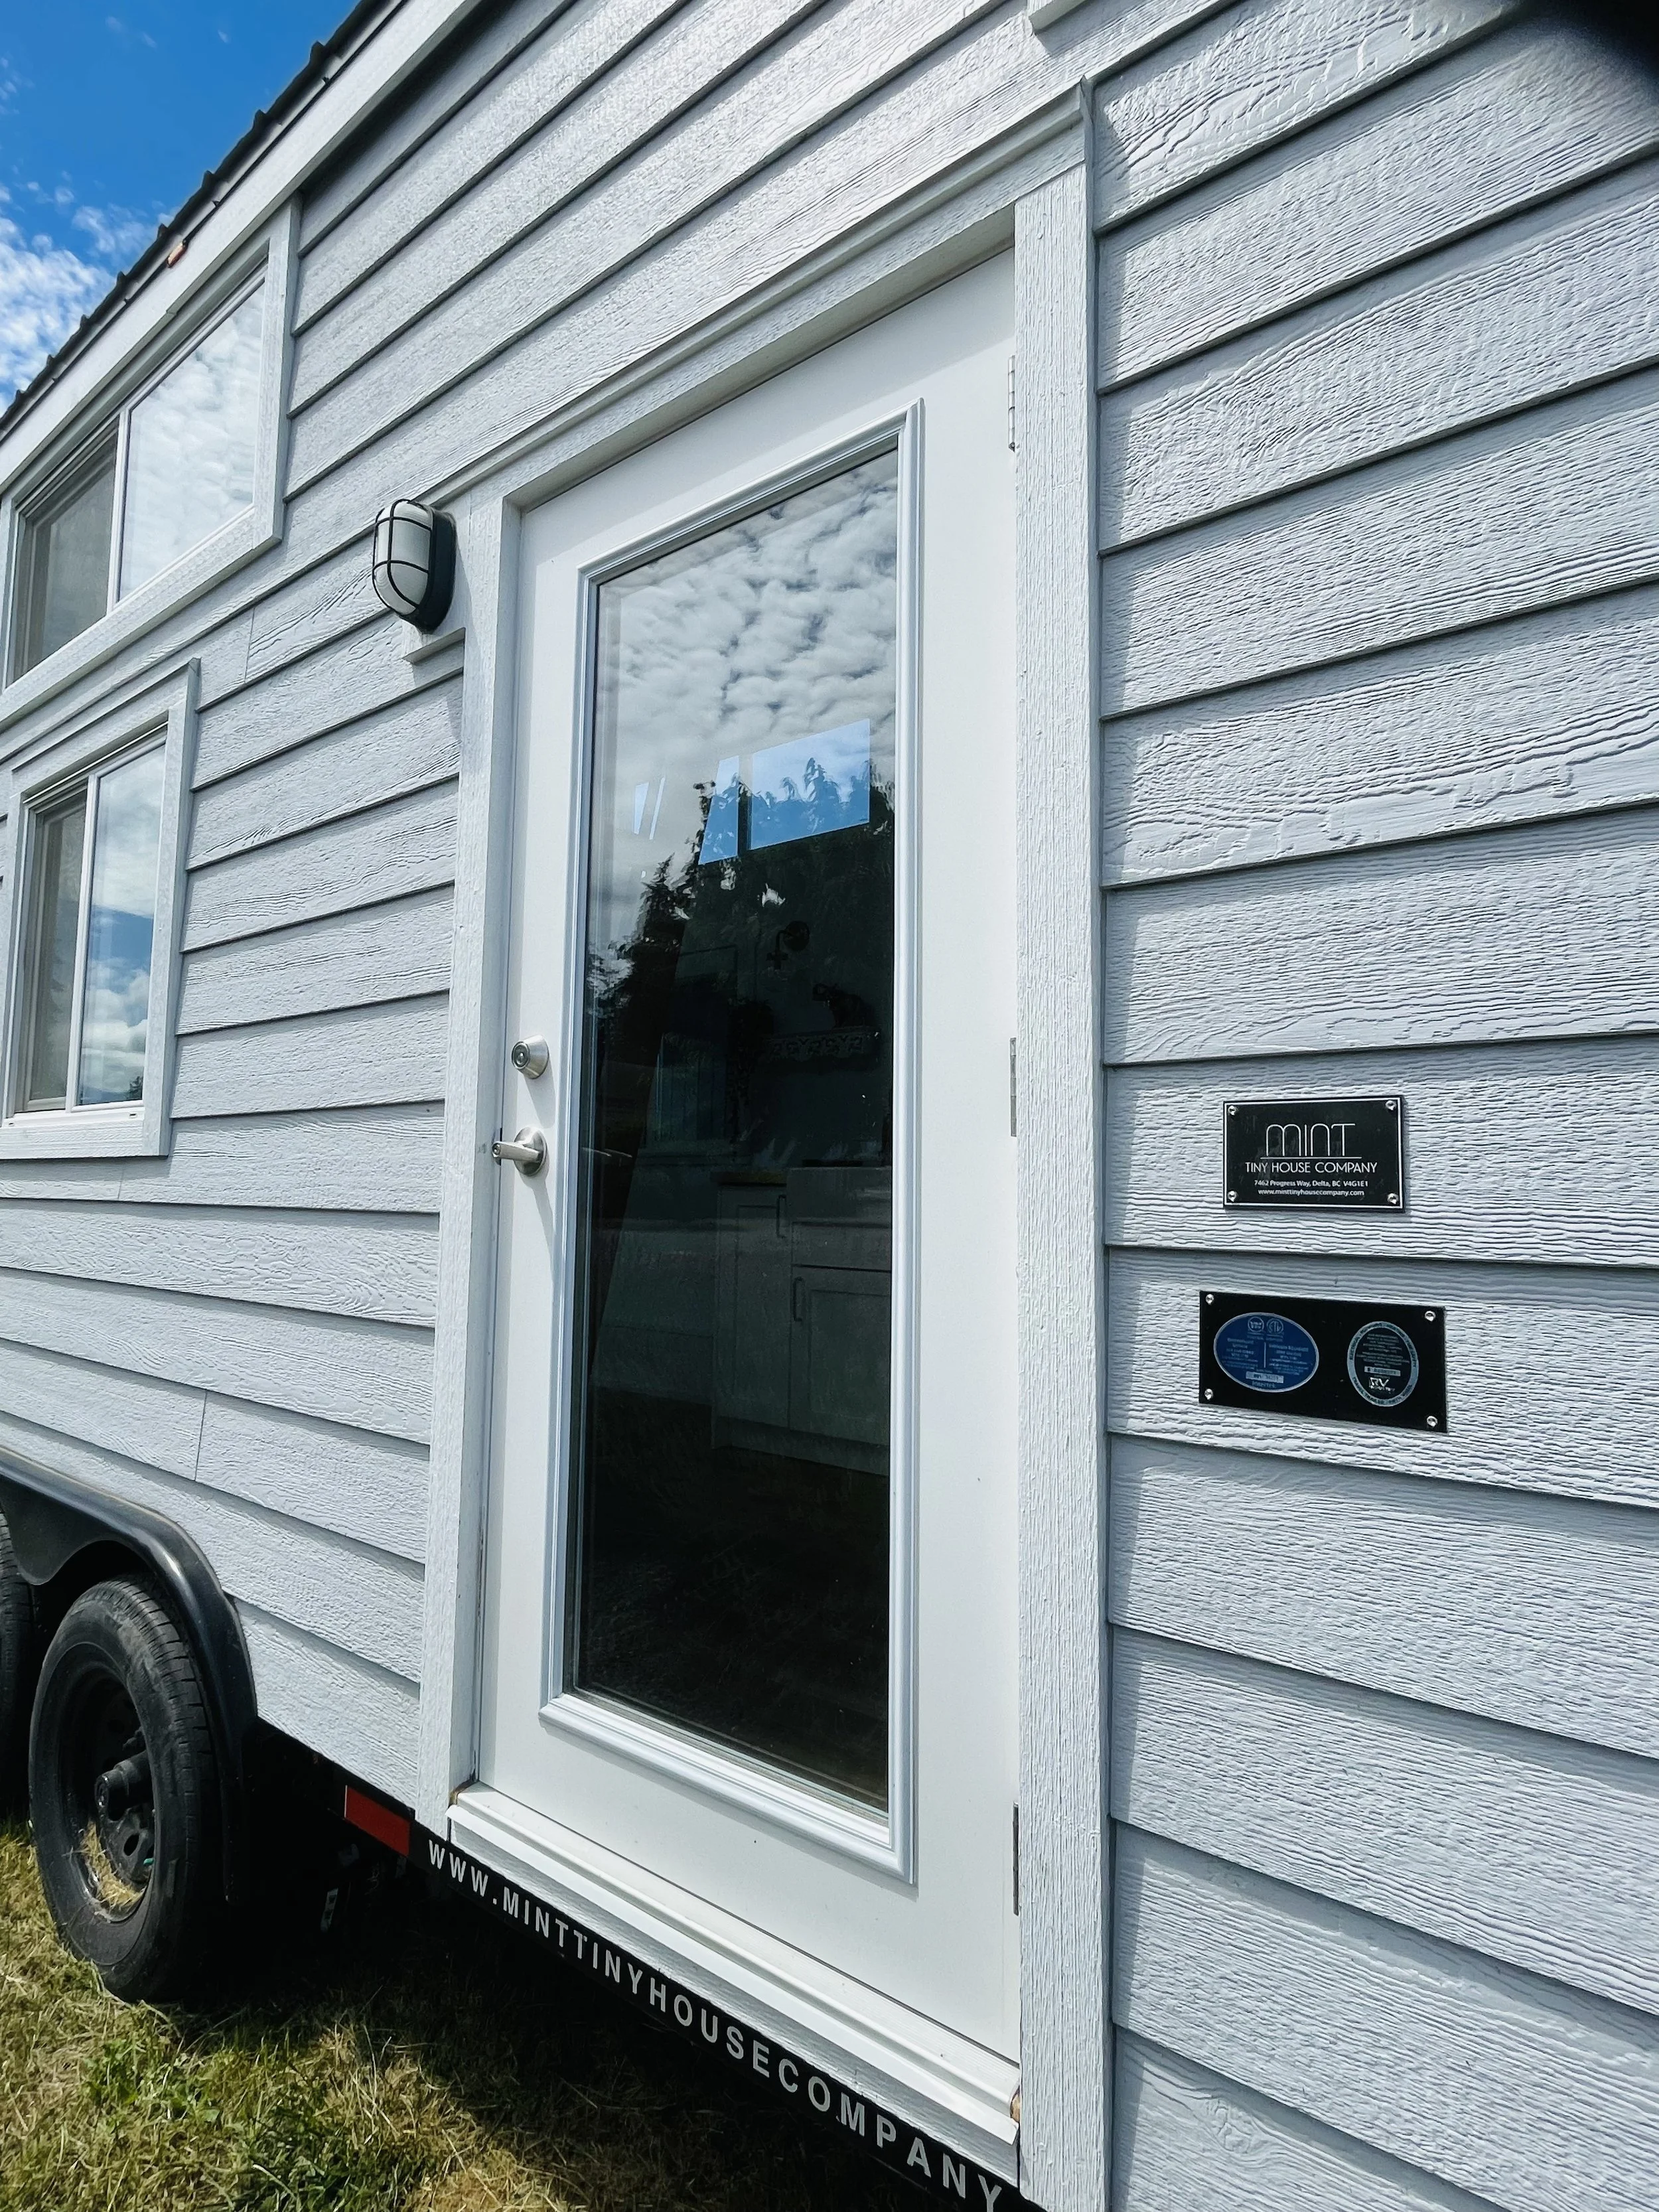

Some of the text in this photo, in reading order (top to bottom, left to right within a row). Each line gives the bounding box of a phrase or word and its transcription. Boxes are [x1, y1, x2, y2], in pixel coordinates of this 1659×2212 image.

[1246, 1162, 1378, 1173] TINY HOUSE COMPANY
